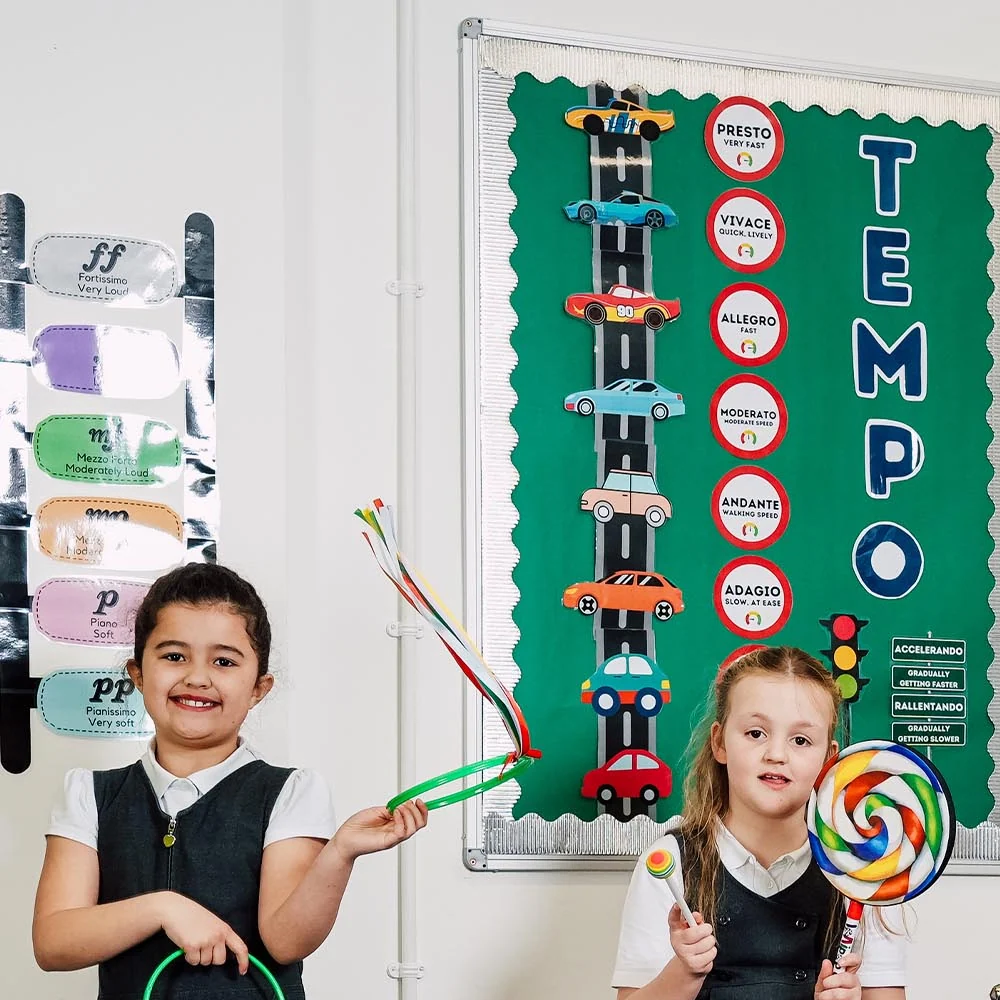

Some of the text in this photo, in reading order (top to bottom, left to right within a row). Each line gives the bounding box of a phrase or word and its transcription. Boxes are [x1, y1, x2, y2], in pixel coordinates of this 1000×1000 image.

[718, 124, 771, 139] PRESTO
[724, 139, 765, 149] VERY FAST
[720, 214, 771, 230] VIVACE
[748, 231, 772, 240] LIVELY
[82, 242, 126, 273] ff
[78, 272, 128, 285] Fortissimo
[77, 283, 129, 296] Very Loud
[721, 313, 777, 327] ALLEGRO
[852, 135, 928, 599] TEMPO
[720, 408, 777, 420] MODERATO
[77, 452, 109, 464] Mezzo
[65, 463, 149, 478] Moderately Loud
[721, 496, 780, 510] ANDANTE
[722, 509, 779, 519] WALKING SPEED
[724, 584, 781, 597] ADAGIO
[92, 590, 120, 616] p
[762, 599, 781, 607] EASE
[90, 617, 118, 628] Piano
[93, 629, 115, 640] Soft
[894, 644, 964, 656] ACCELERANDO
[907, 669, 951, 678] GRADUALLY
[89, 677, 136, 703] pp
[899, 680, 959, 689] GETTING FASTER
[86, 705, 137, 717] Pianissimo
[894, 701, 964, 712] RALLENTANDO
[88, 717, 135, 729] Very soft
[907, 725, 951, 733] GRADUALLY
[897, 735, 960, 744] GETTING SLOWER
